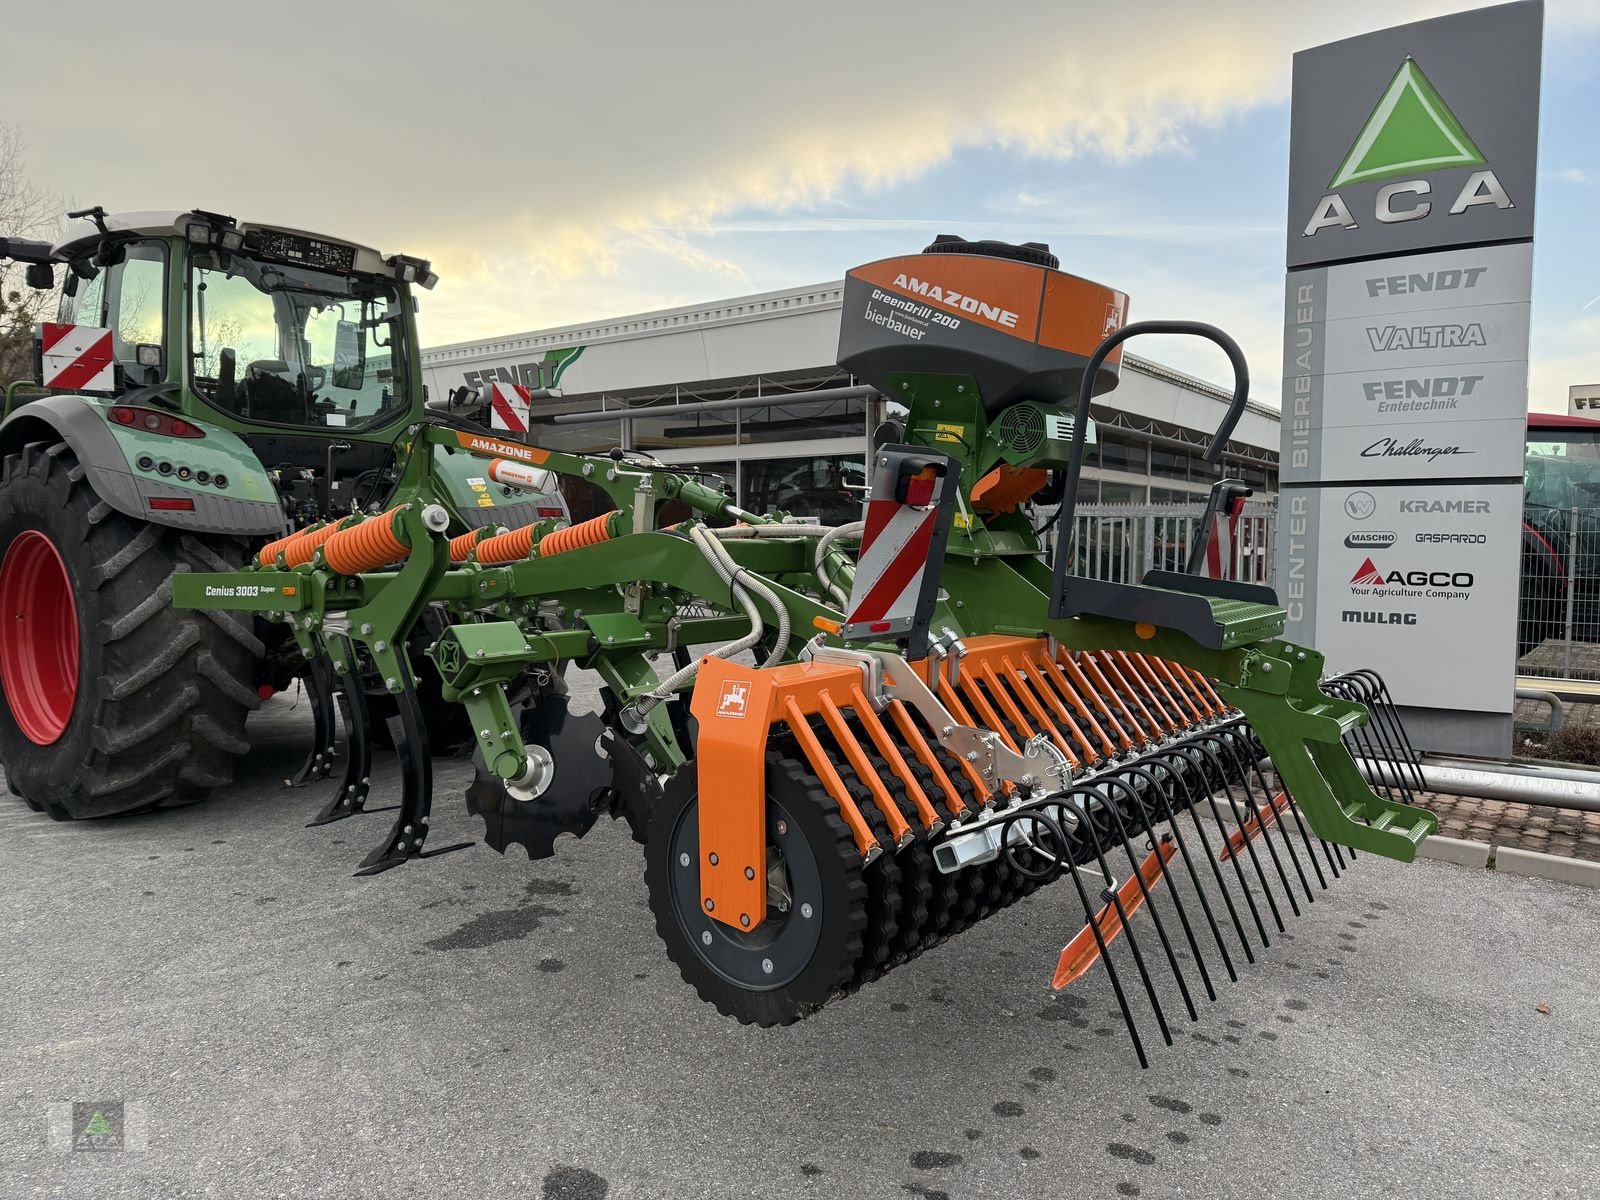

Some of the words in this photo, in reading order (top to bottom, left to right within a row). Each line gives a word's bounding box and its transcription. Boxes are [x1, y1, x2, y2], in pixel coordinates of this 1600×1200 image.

[1302, 170, 1516, 237] ACA
[1365, 267, 1487, 297] FENDT
[872, 289, 932, 319] GreenDrill
[932, 312, 961, 330] 200
[893, 274, 1020, 329] AMAZONE
[865, 301, 926, 340] bierbauer
[1366, 323, 1487, 352] VALTRA
[1292, 284, 1314, 468] BIERBAUER
[1362, 376, 1484, 400] FENDT
[1378, 398, 1458, 412] Erntetechnik
[471, 439, 532, 460] AMAZONE
[1360, 438, 1477, 462] Challenger
[1400, 500, 1491, 513] KRAMER
[1416, 534, 1486, 543] GASPARDO
[1286, 496, 1307, 623] CENTER
[206, 585, 234, 596] Cenius
[236, 586, 258, 597] 3003
[1386, 571, 1473, 587] AGCO
[1351, 587, 1370, 595] Your
[1372, 588, 1422, 598] Agriculture
[1426, 589, 1470, 600] Company
